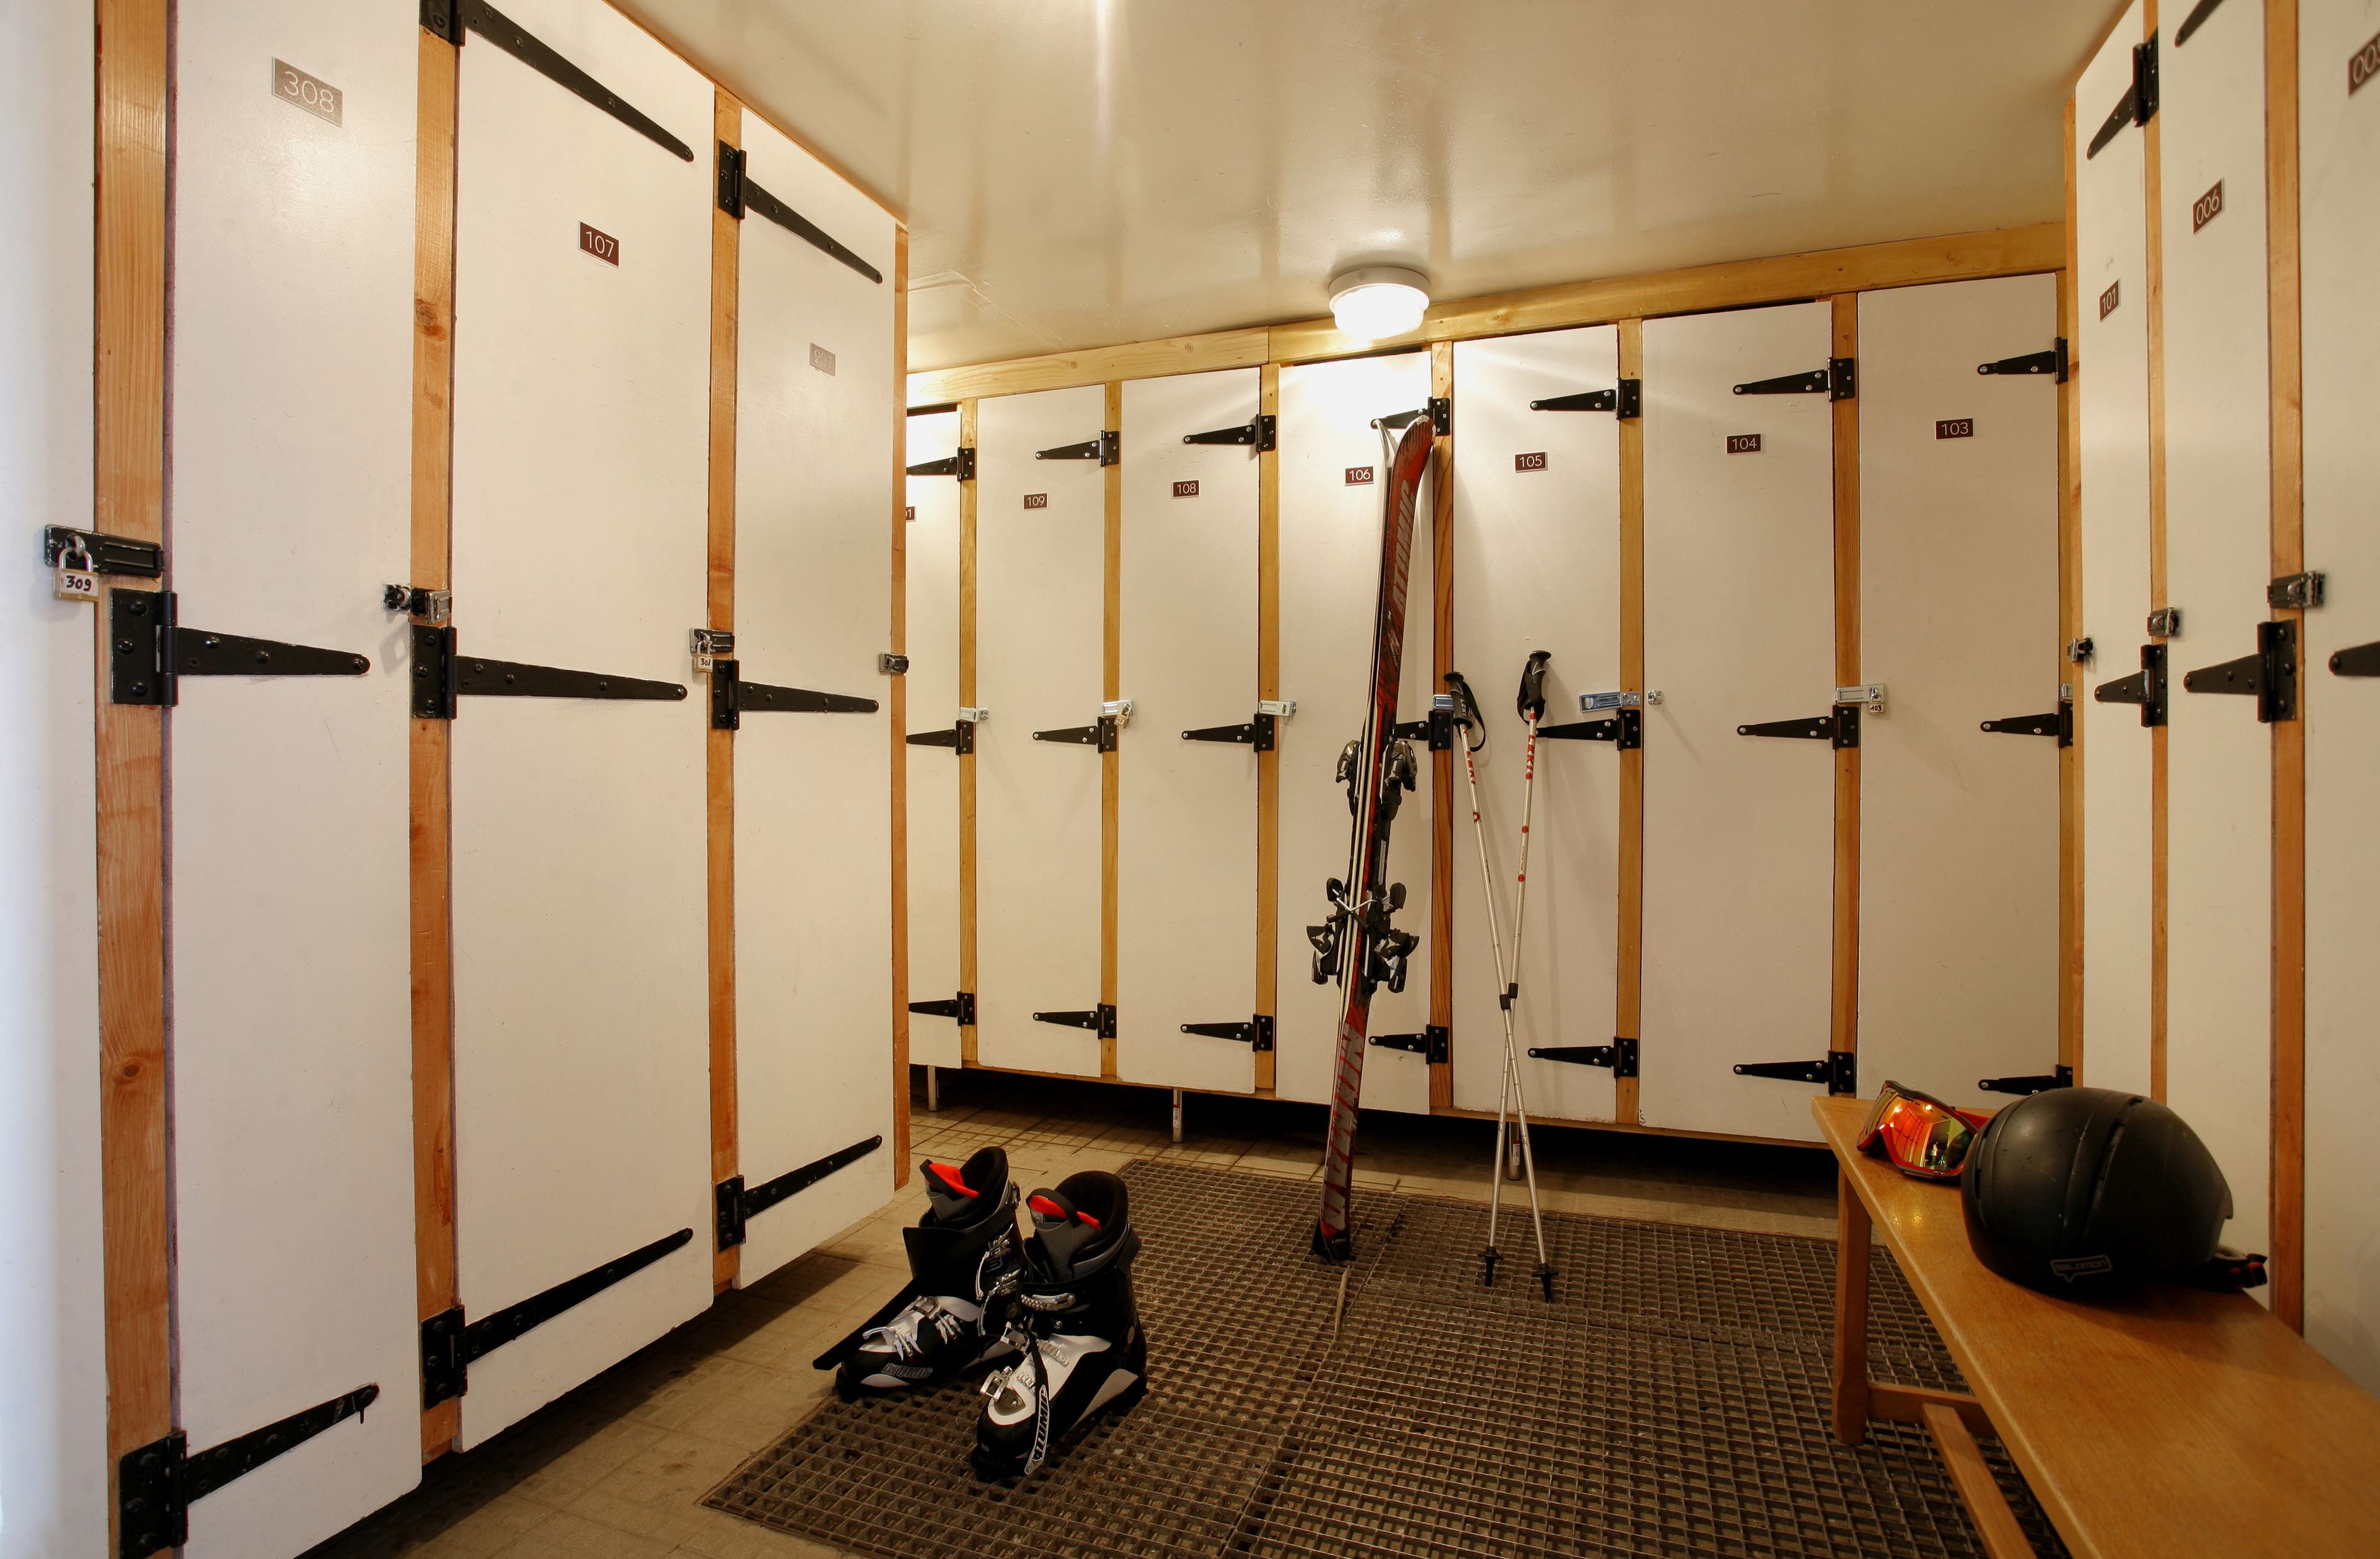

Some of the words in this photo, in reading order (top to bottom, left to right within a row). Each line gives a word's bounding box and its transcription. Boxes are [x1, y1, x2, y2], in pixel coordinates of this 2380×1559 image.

[2353, 35, 2380, 84] 00
[284, 71, 334, 113] 308
[2196, 188, 2219, 224] 006
[585, 231, 615, 258] 107
[2102, 288, 2116, 313] 101
[1941, 422, 1969, 436] 103
[1731, 436, 1758, 451] 104
[1518, 455, 1543, 468] 105
[1349, 469, 1371, 481] 106
[1176, 483, 1197, 494] 108
[1026, 496, 1046, 506] 109
[1393, 480, 1414, 616] ATOMIC
[66, 575, 92, 592] 309
[1460, 698, 1468, 717] LEKI
